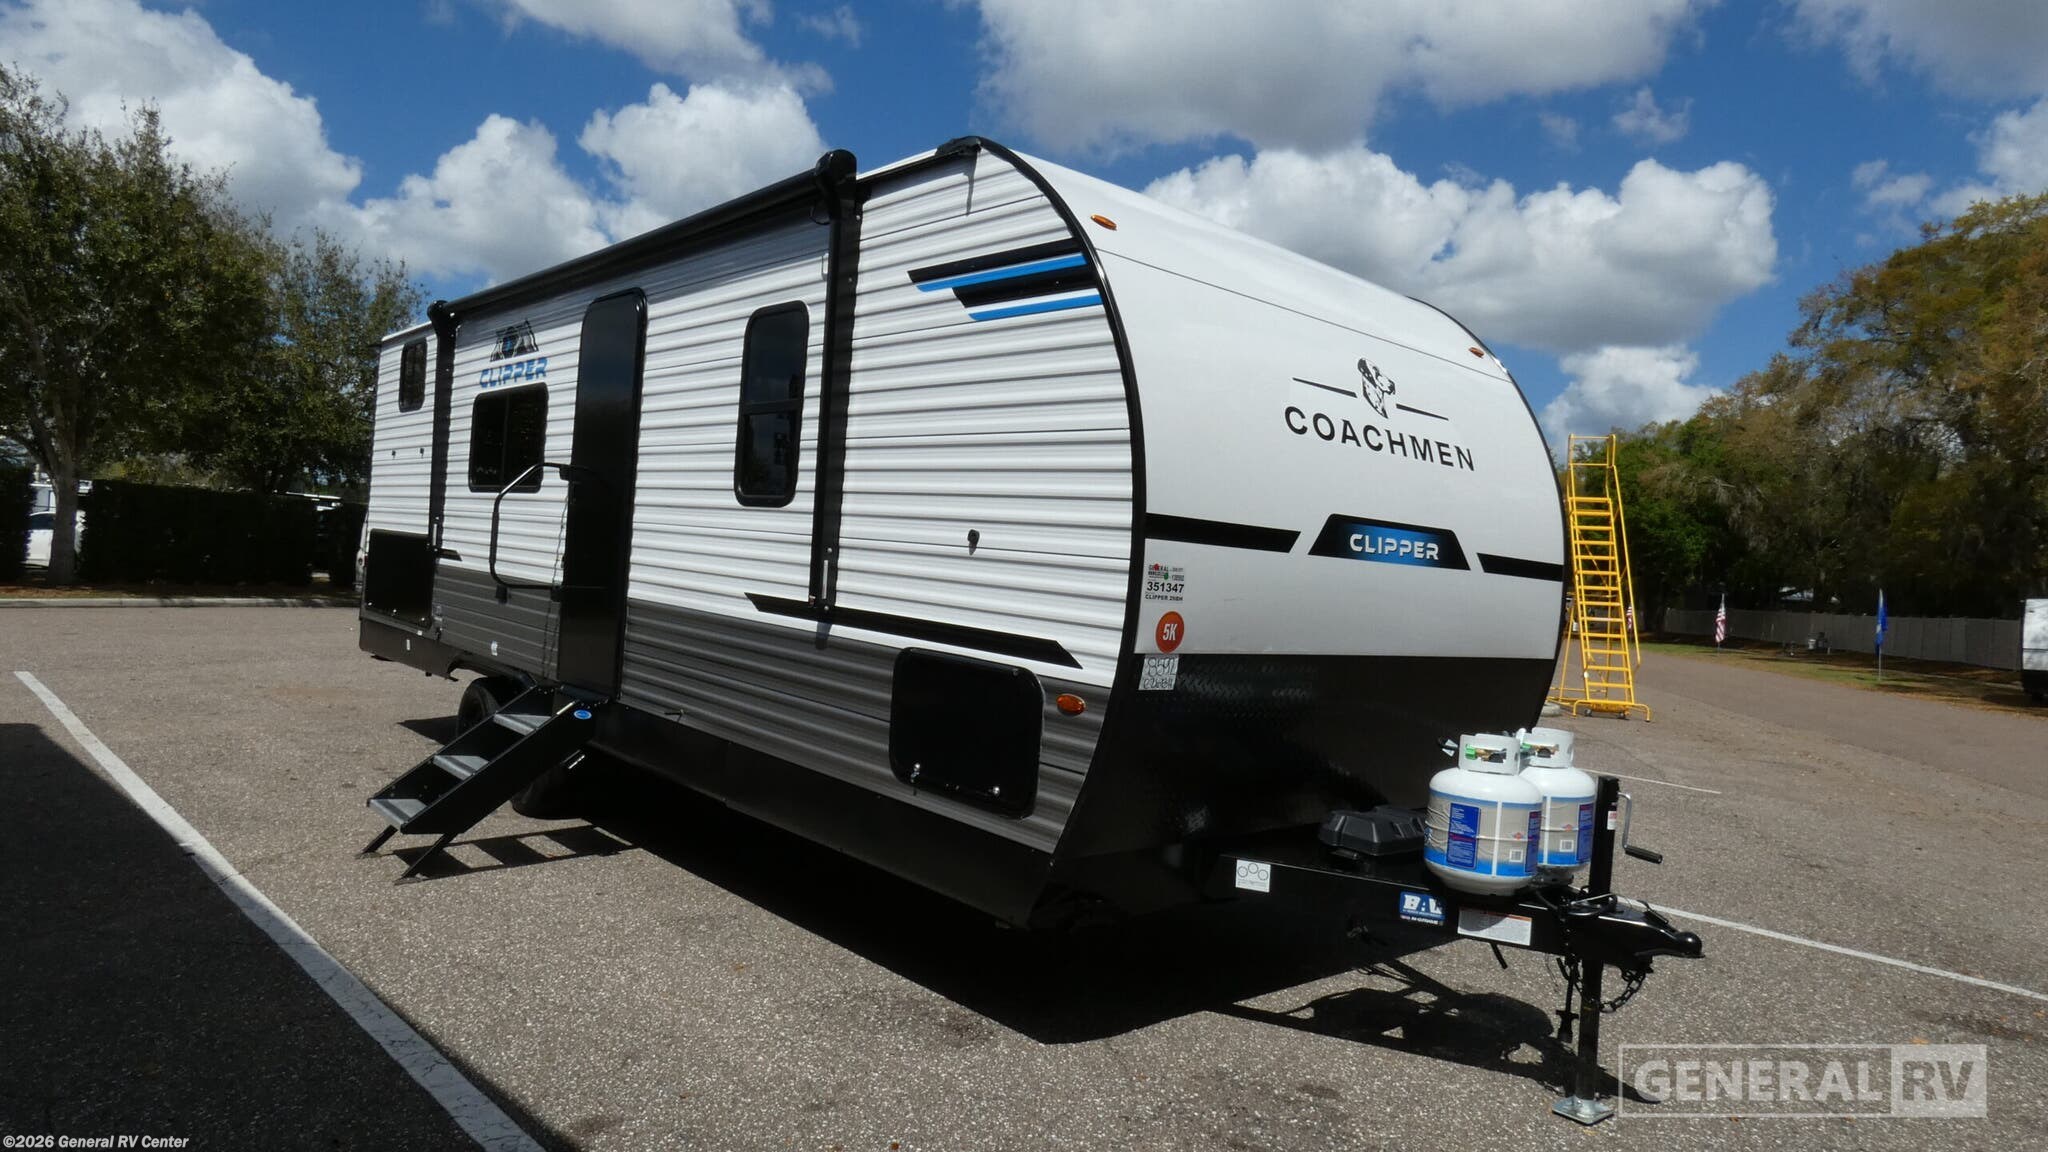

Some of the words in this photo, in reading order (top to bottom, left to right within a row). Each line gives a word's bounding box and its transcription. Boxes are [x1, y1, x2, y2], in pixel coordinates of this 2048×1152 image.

[480, 357, 548, 388] CLIPPER
[1284, 405, 1475, 472] COACHMEN
[1349, 533, 1440, 561] CLIPPER
[1146, 581, 1185, 593] 351347
[1162, 623, 1178, 641] 5K
